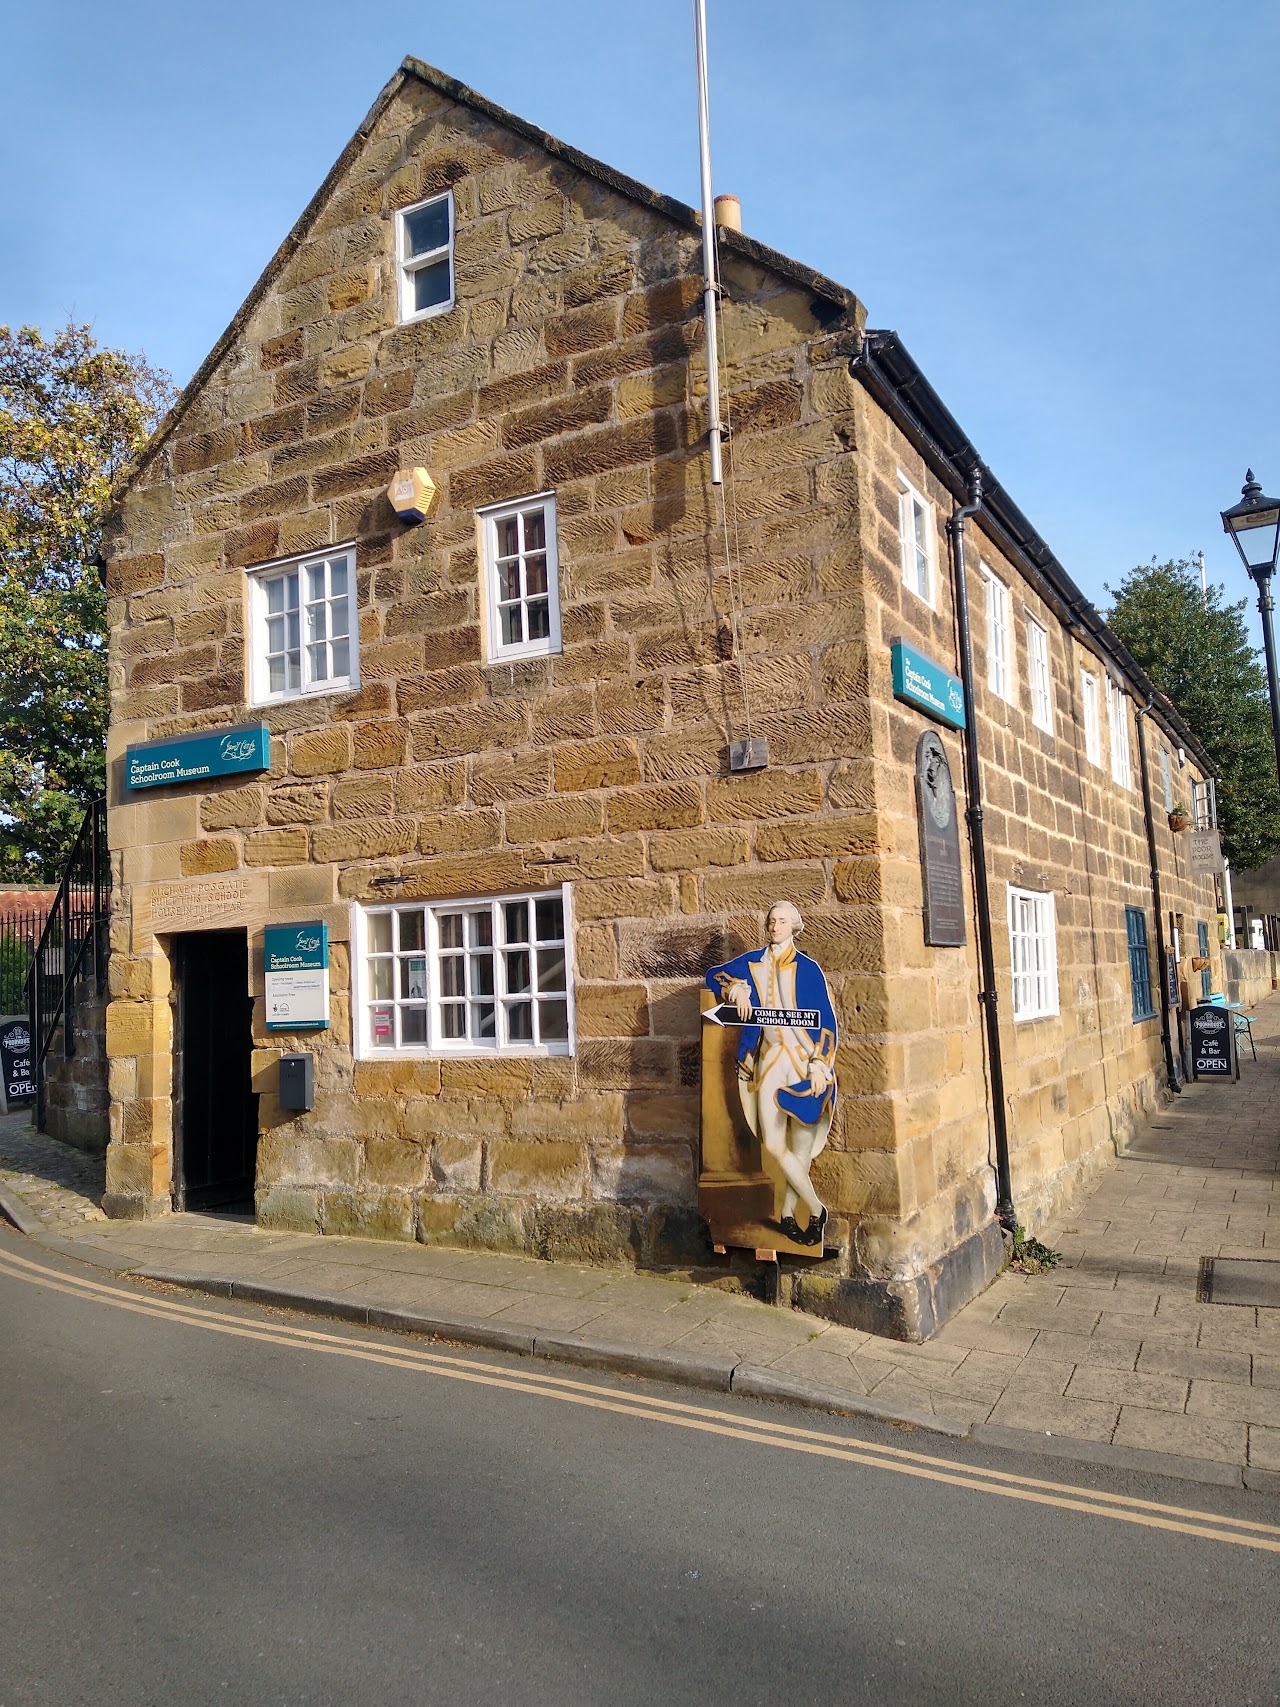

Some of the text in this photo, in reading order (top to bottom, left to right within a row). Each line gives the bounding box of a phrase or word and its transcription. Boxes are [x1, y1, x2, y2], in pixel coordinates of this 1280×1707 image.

[905, 665, 922, 684] Captain
[130, 758, 180, 774] Captain Cook
[130, 765, 210, 785] Schoolroom Museum
[151, 890, 245, 907] BUILT THIS SCHOOL
[151, 907, 181, 918] HOUSE
[193, 904, 213, 914] THE
[216, 902, 243, 913] YEAR
[754, 1009, 777, 1017] COME
[786, 1011, 802, 1019] SEE
[803, 1012, 816, 1020] MY
[756, 1017, 814, 1026] SCHOOL ROOM
[1202, 1039, 1219, 1047] Café
[1200, 1047, 1221, 1055] & Bar
[1196, 1060, 1227, 1069] OPEN
[20, 1068, 30, 1076] Ba
